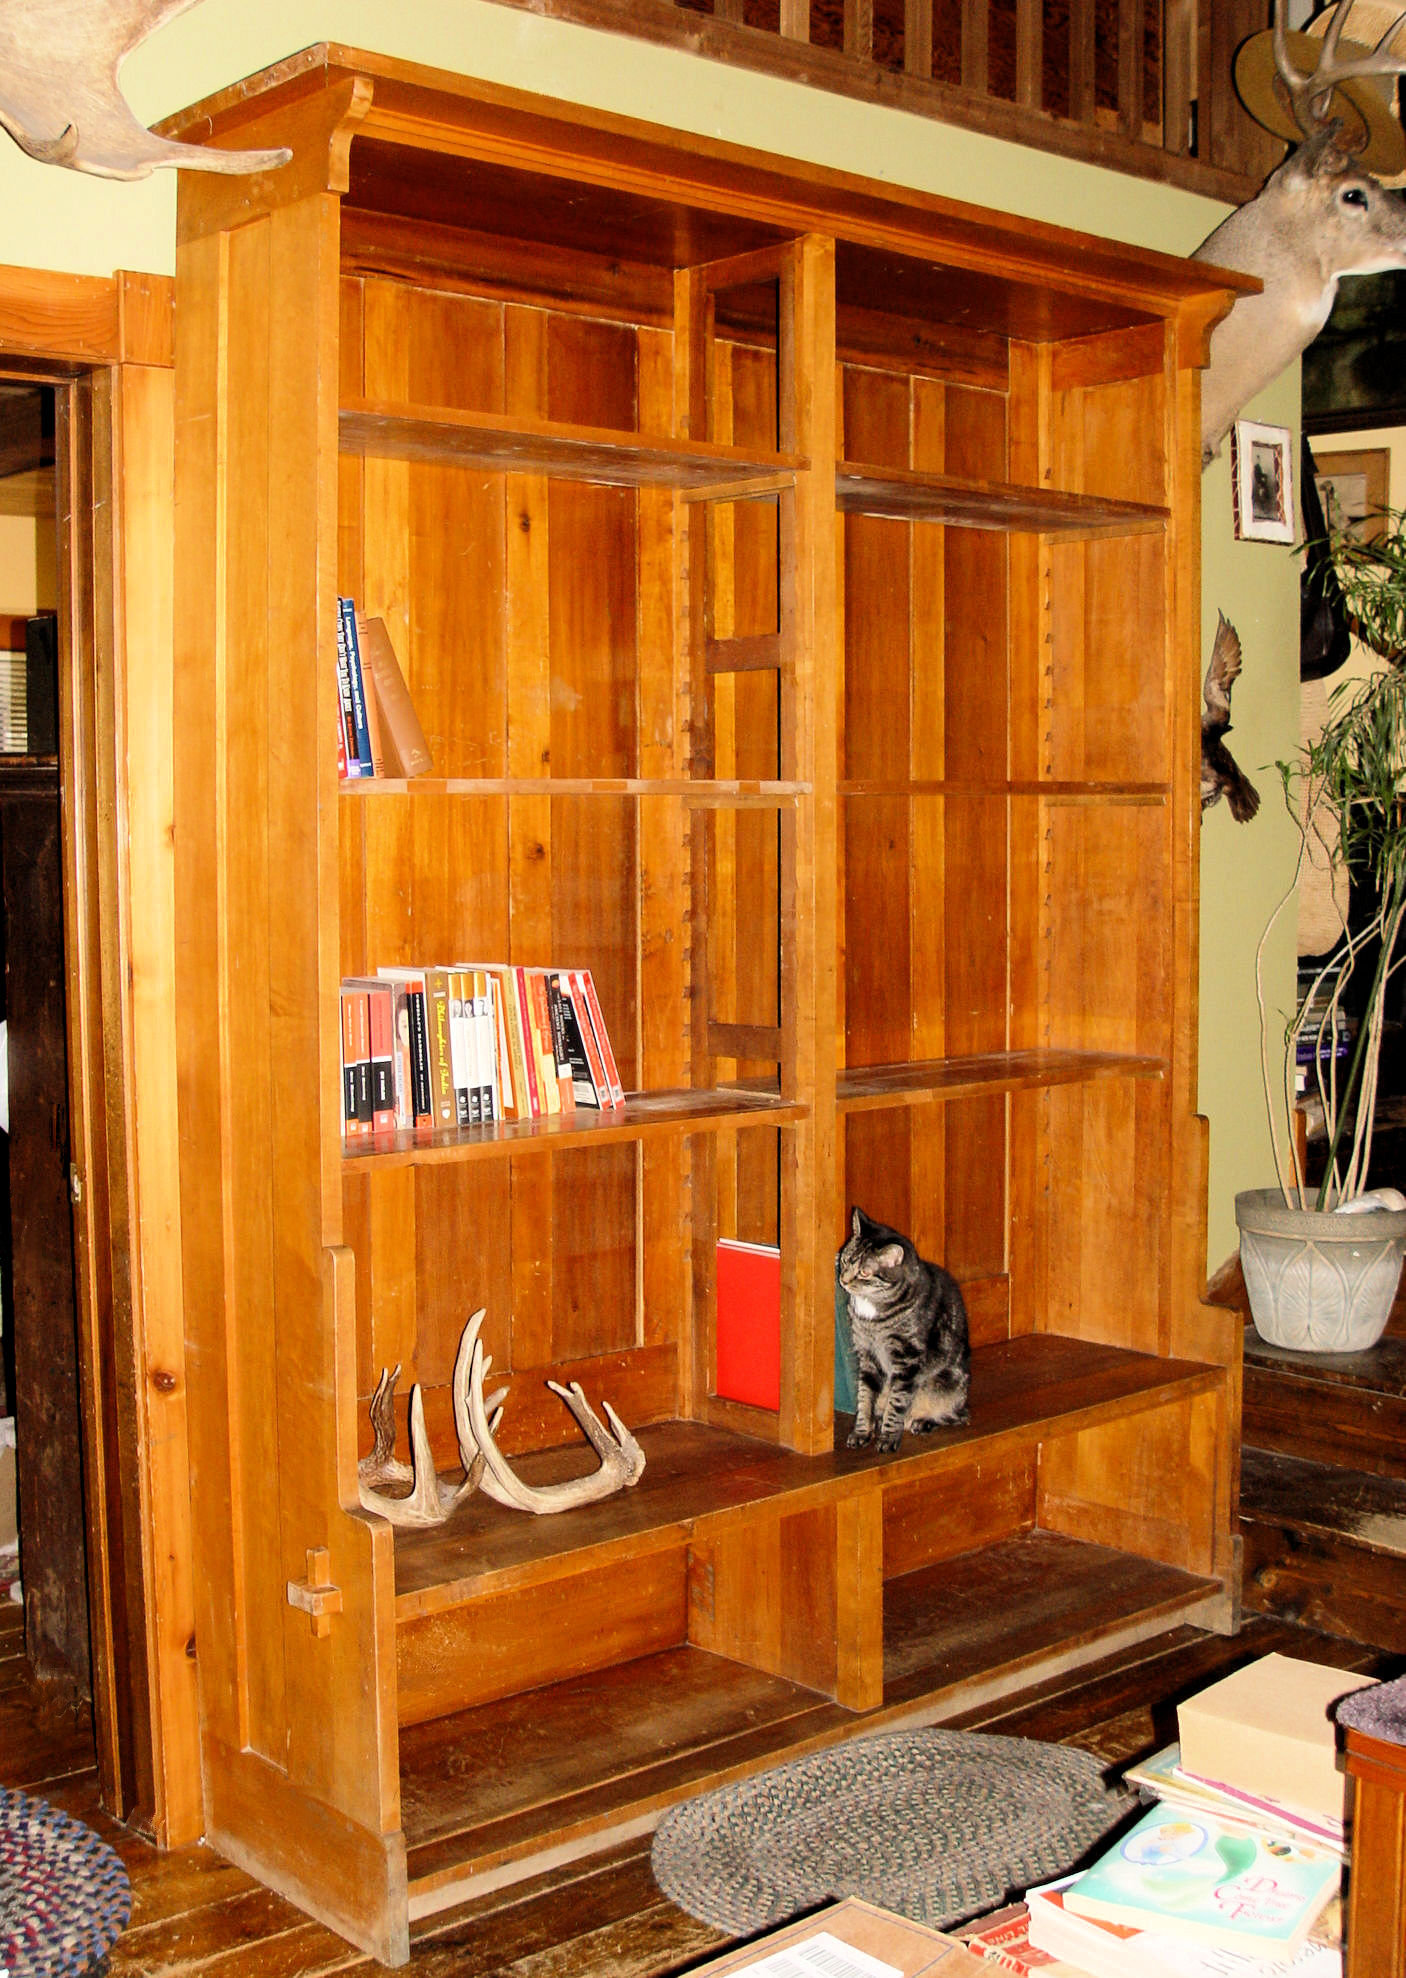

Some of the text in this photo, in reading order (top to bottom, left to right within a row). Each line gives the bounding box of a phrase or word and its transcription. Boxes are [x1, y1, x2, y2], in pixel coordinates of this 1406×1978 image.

[345, 616, 354, 650] Language,
[350, 651, 359, 689] Psychology,
[436, 1000, 448, 1056] Philosophies
[440, 1067, 449, 1095] India
